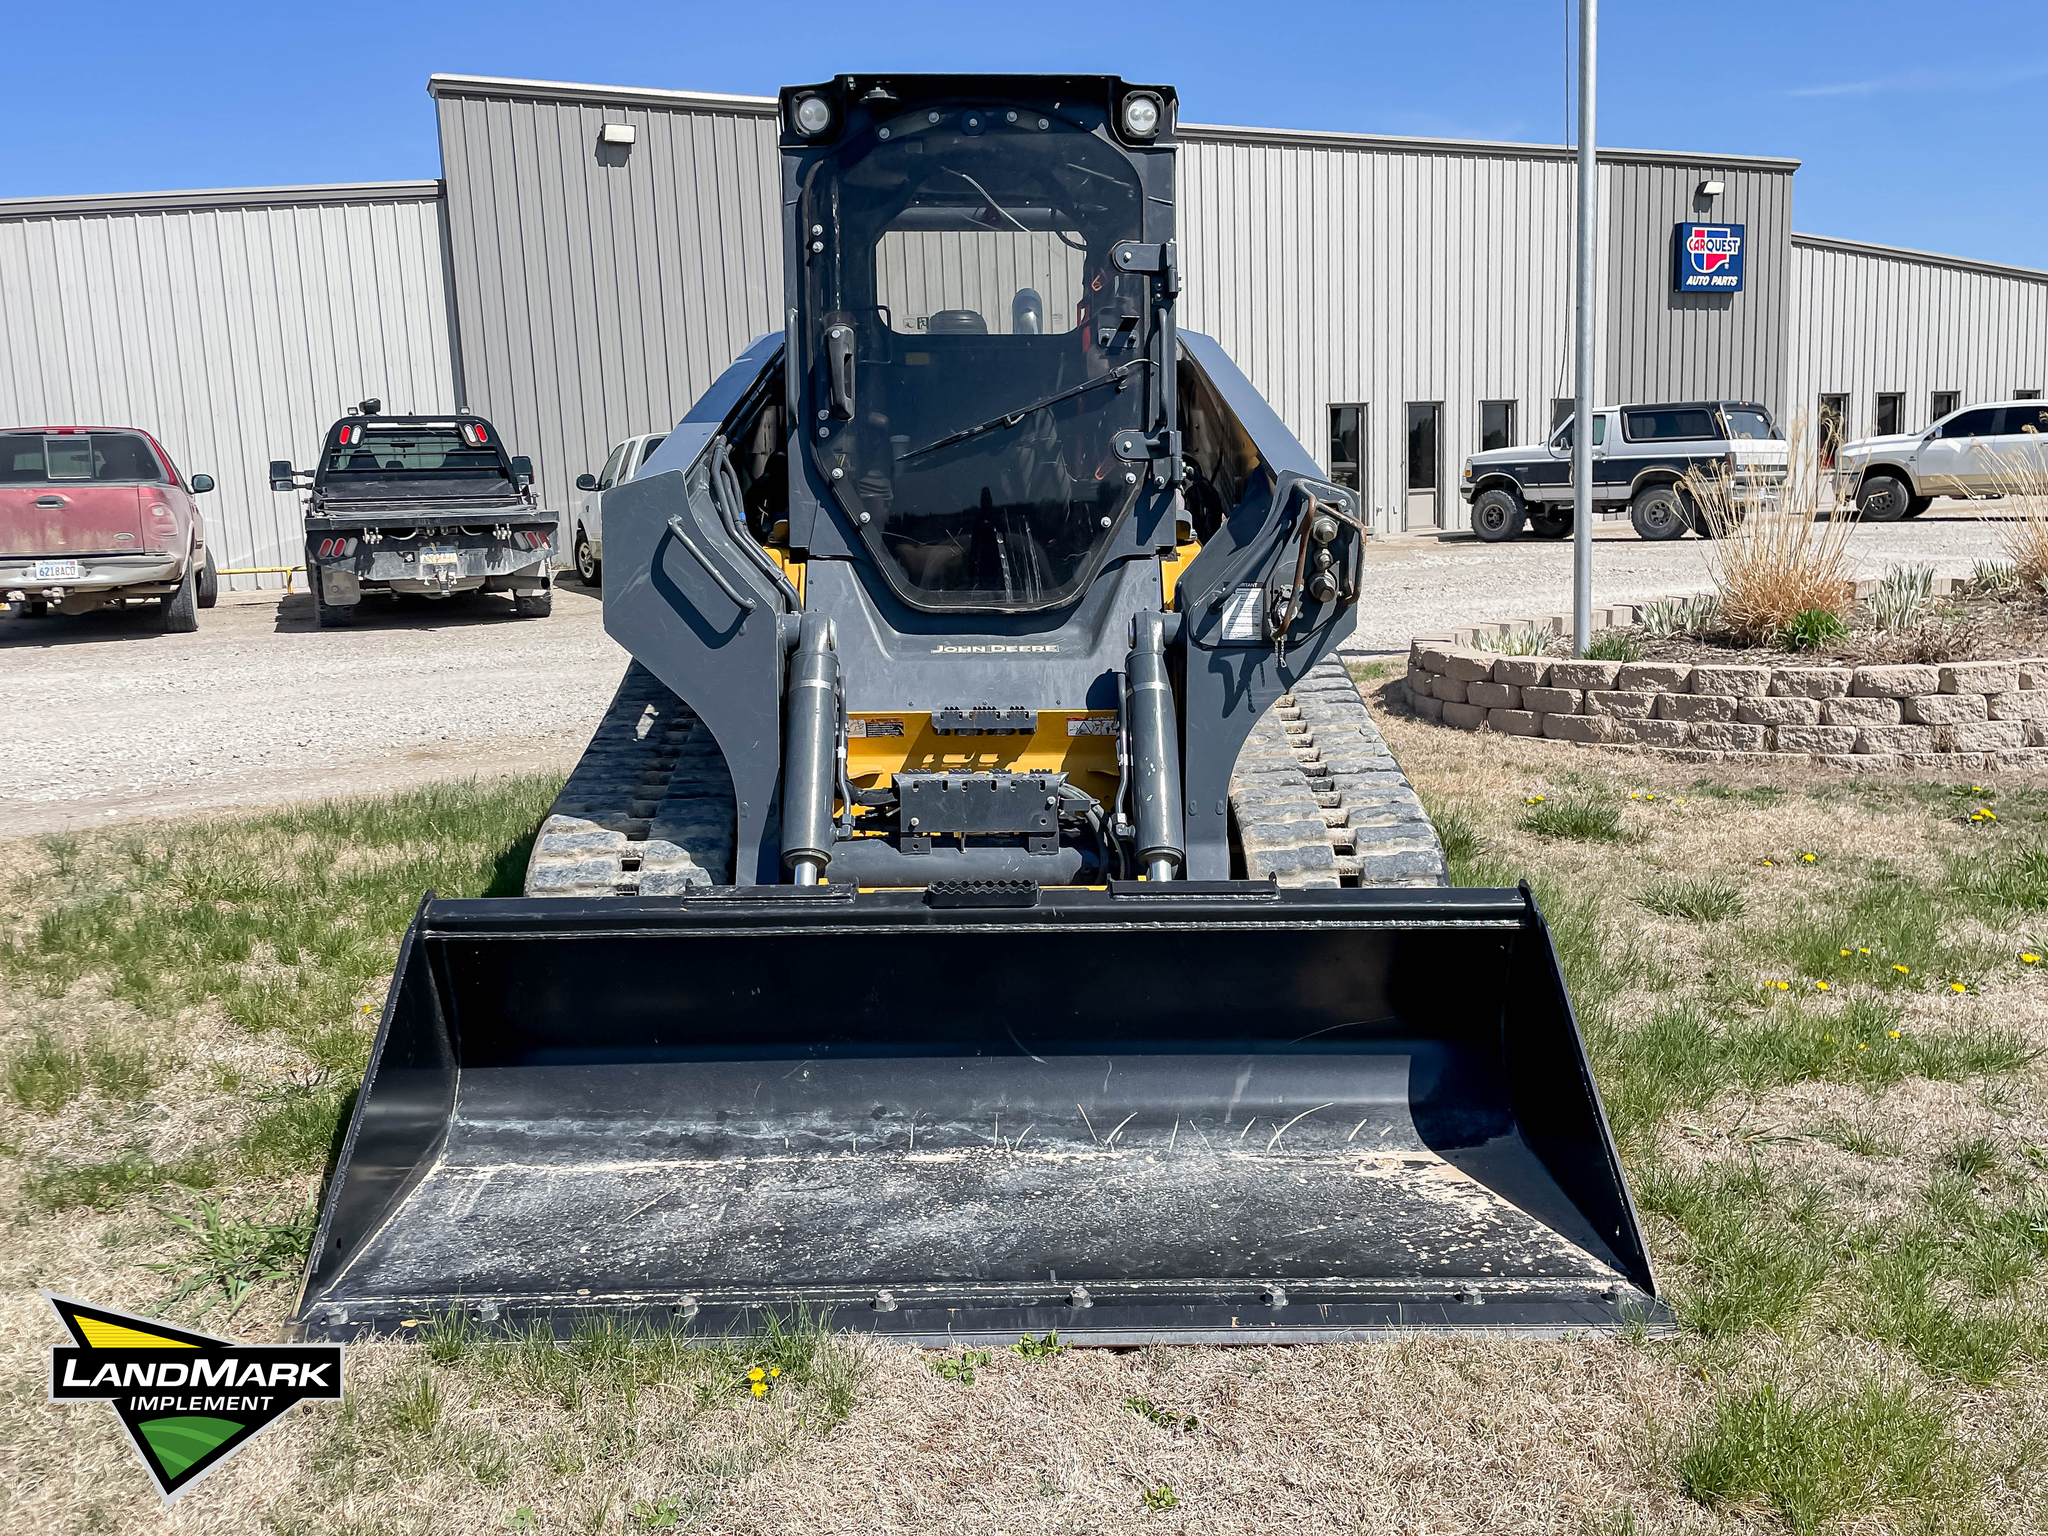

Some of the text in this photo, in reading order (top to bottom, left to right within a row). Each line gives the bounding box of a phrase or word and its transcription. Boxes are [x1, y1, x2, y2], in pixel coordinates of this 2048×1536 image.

[1688, 238, 1739, 252] CARQUEST
[1686, 275, 1739, 287] AUTO PARTS
[931, 644, 1060, 653] JOHN DEERE
